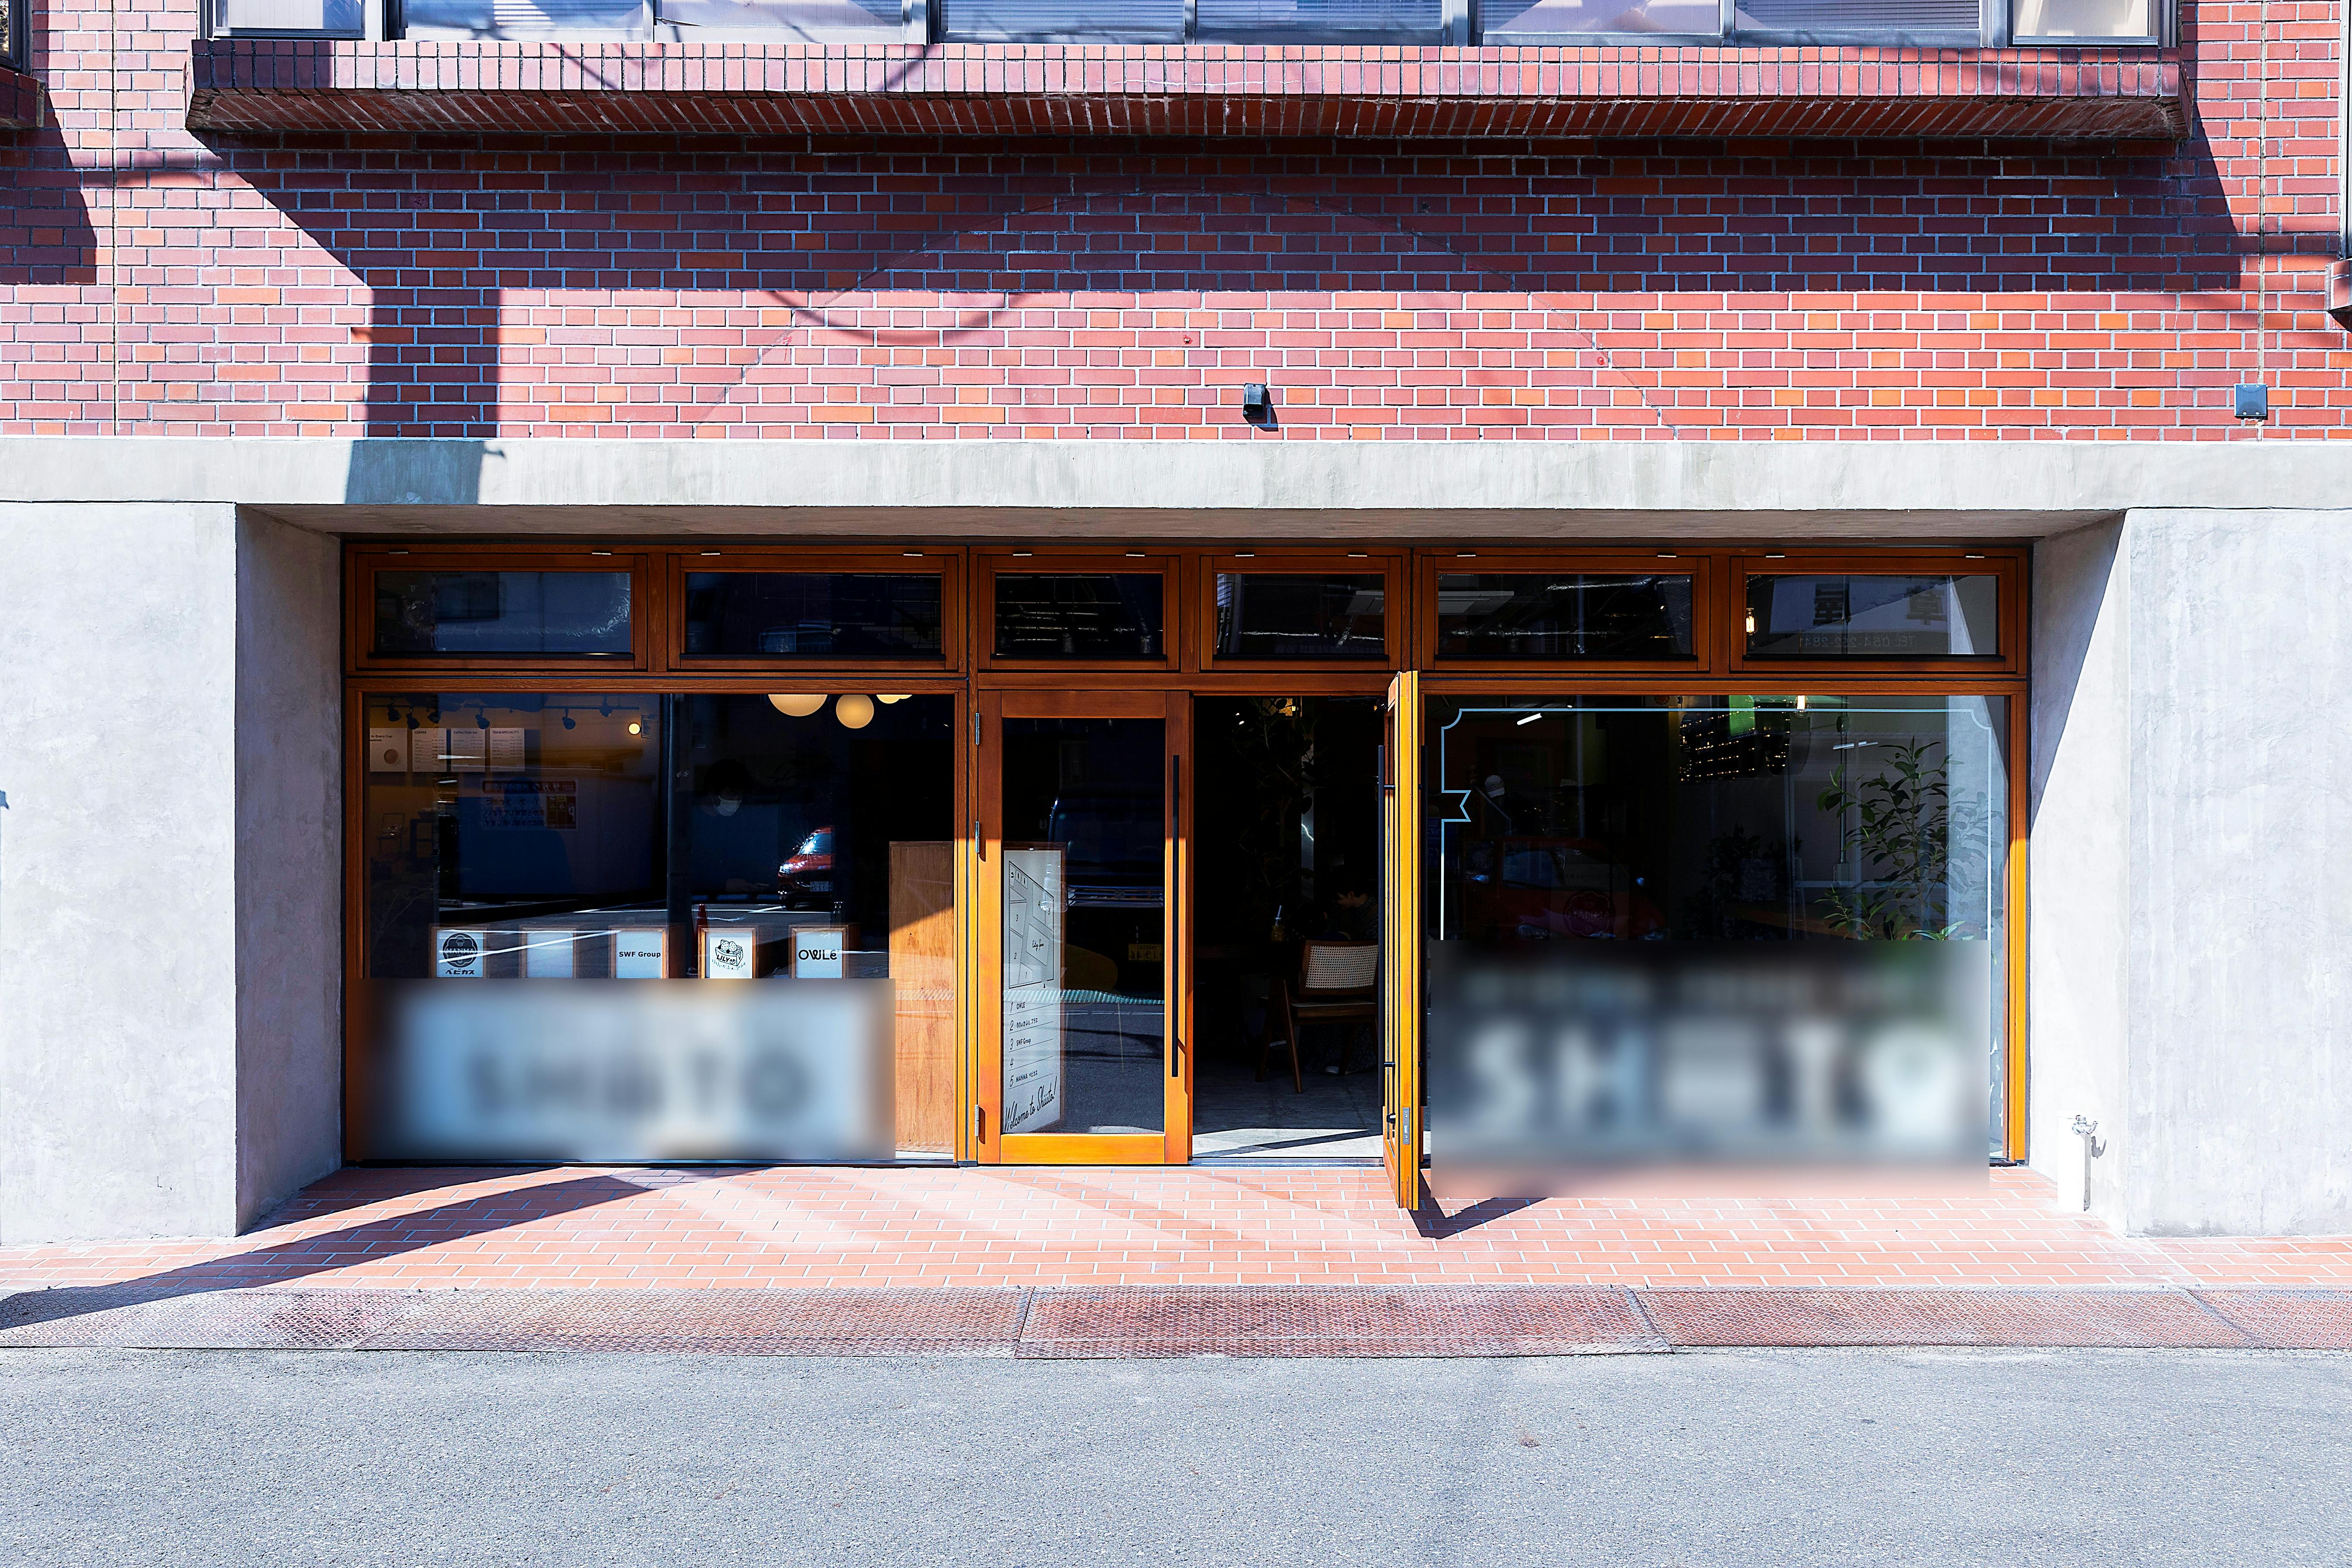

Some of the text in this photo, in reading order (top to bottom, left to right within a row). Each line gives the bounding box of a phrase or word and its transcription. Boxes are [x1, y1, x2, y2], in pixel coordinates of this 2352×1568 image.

[1010, 1002, 1013, 1013] 1
[1009, 1020, 1014, 1032] 2
[1010, 1038, 1014, 1050] 3
[1010, 1057, 1014, 1068] 4
[1009, 1075, 1014, 1087] 5
[1016, 1074, 1028, 1082] MANMA
[1004, 1101, 1029, 1132] Welcome
[1030, 1095, 1036, 1116] to
